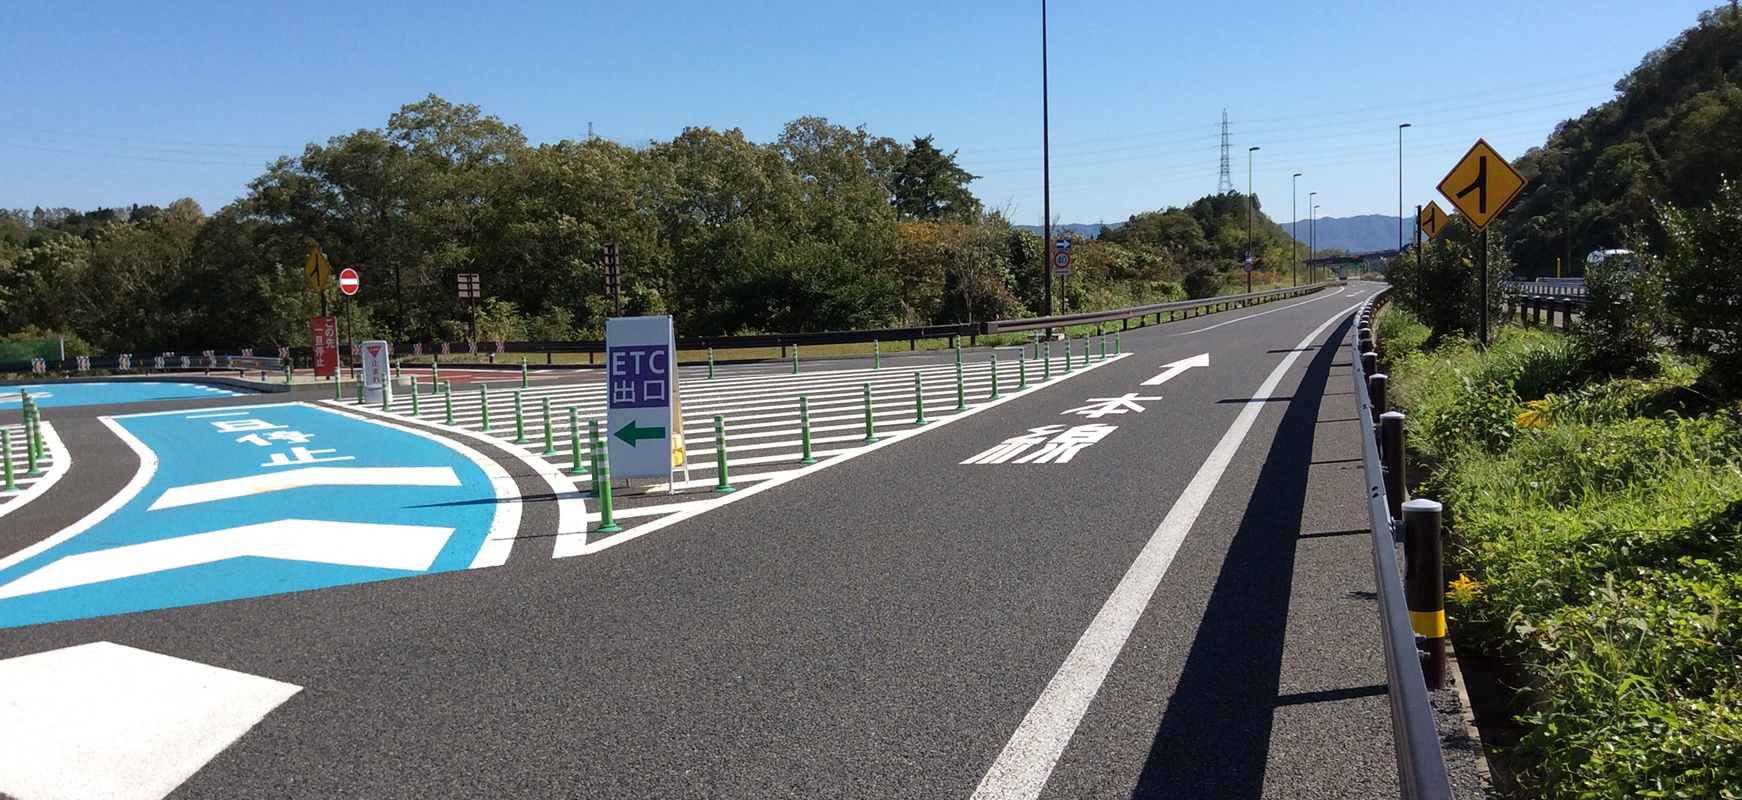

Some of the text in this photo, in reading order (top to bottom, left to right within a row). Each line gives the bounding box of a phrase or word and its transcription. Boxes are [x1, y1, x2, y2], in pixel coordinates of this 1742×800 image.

[1057, 255, 1067, 264] 40
[314, 328, 325, 367] 一旦停止
[325, 319, 335, 349] この先
[372, 360, 380, 383] 止まれ
[612, 350, 665, 376] ETC
[613, 380, 665, 403] 出口
[186, 412, 355, 467] 一旦停止
[959, 393, 1163, 464] 本線
